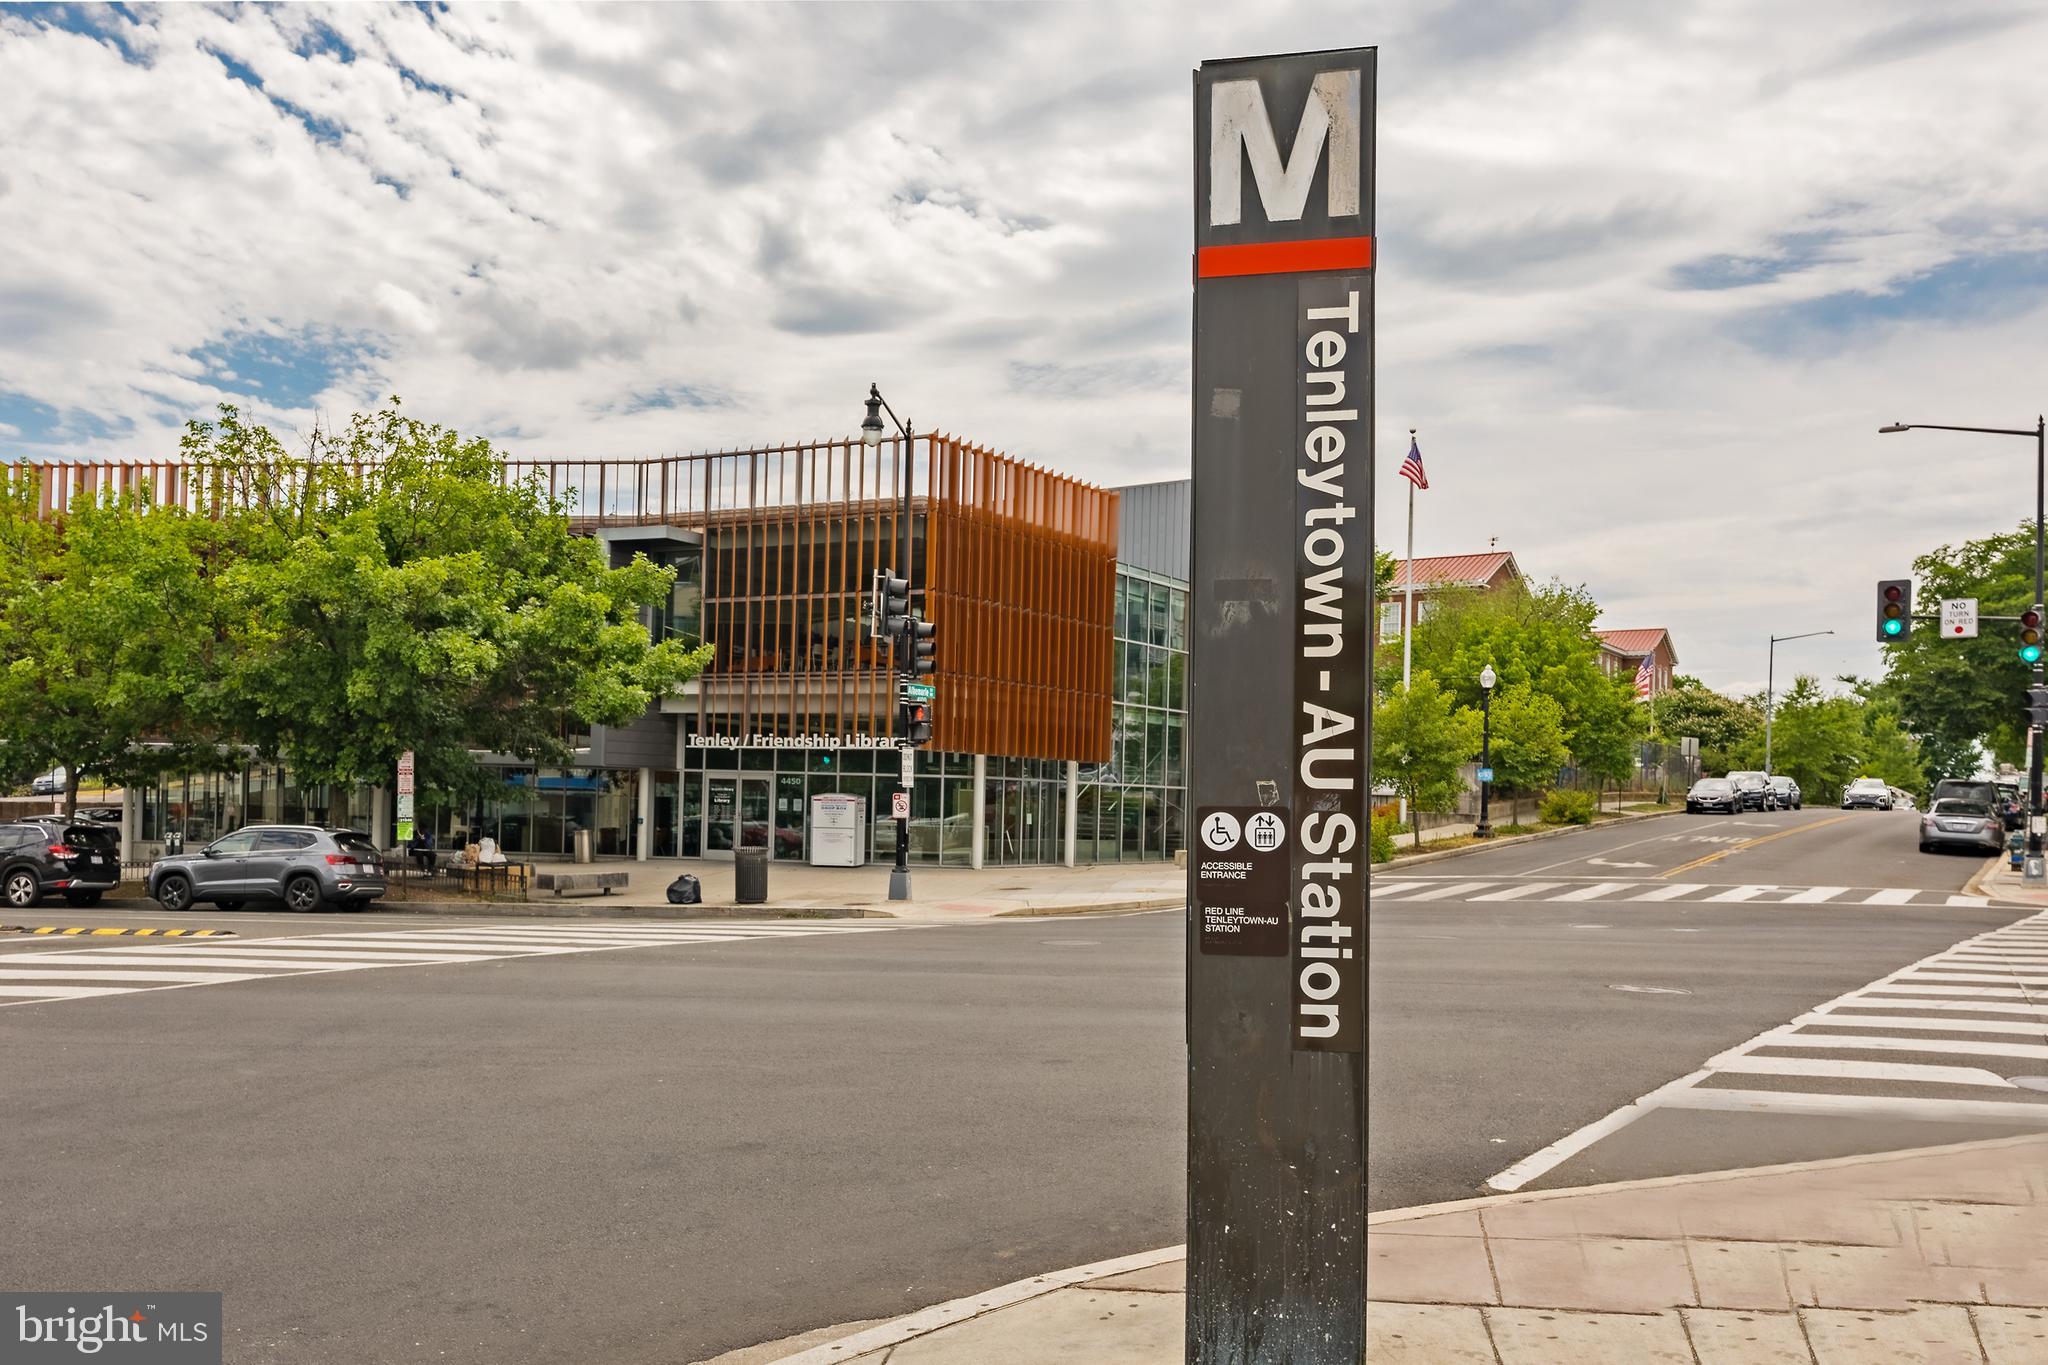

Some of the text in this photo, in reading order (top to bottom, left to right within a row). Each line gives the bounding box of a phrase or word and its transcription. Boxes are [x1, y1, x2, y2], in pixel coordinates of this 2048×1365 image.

[1210, 69, 1361, 227] M
[1951, 602, 1966, 610] NO
[688, 733, 740, 750] Tenley
[753, 733, 841, 751] Friendship
[846, 733, 897, 748] Librar
[781, 777, 801, 785] 4450
[1201, 862, 1253, 871] ACCESSIBLE
[1201, 871, 1247, 880] ENTRANCE
[1205, 907, 1245, 916] RED LINE
[1205, 916, 1279, 925] TENLEYTOWN-AU
[1205, 925, 1240, 933] STATION
[1300, 812, 1357, 1039] Station
